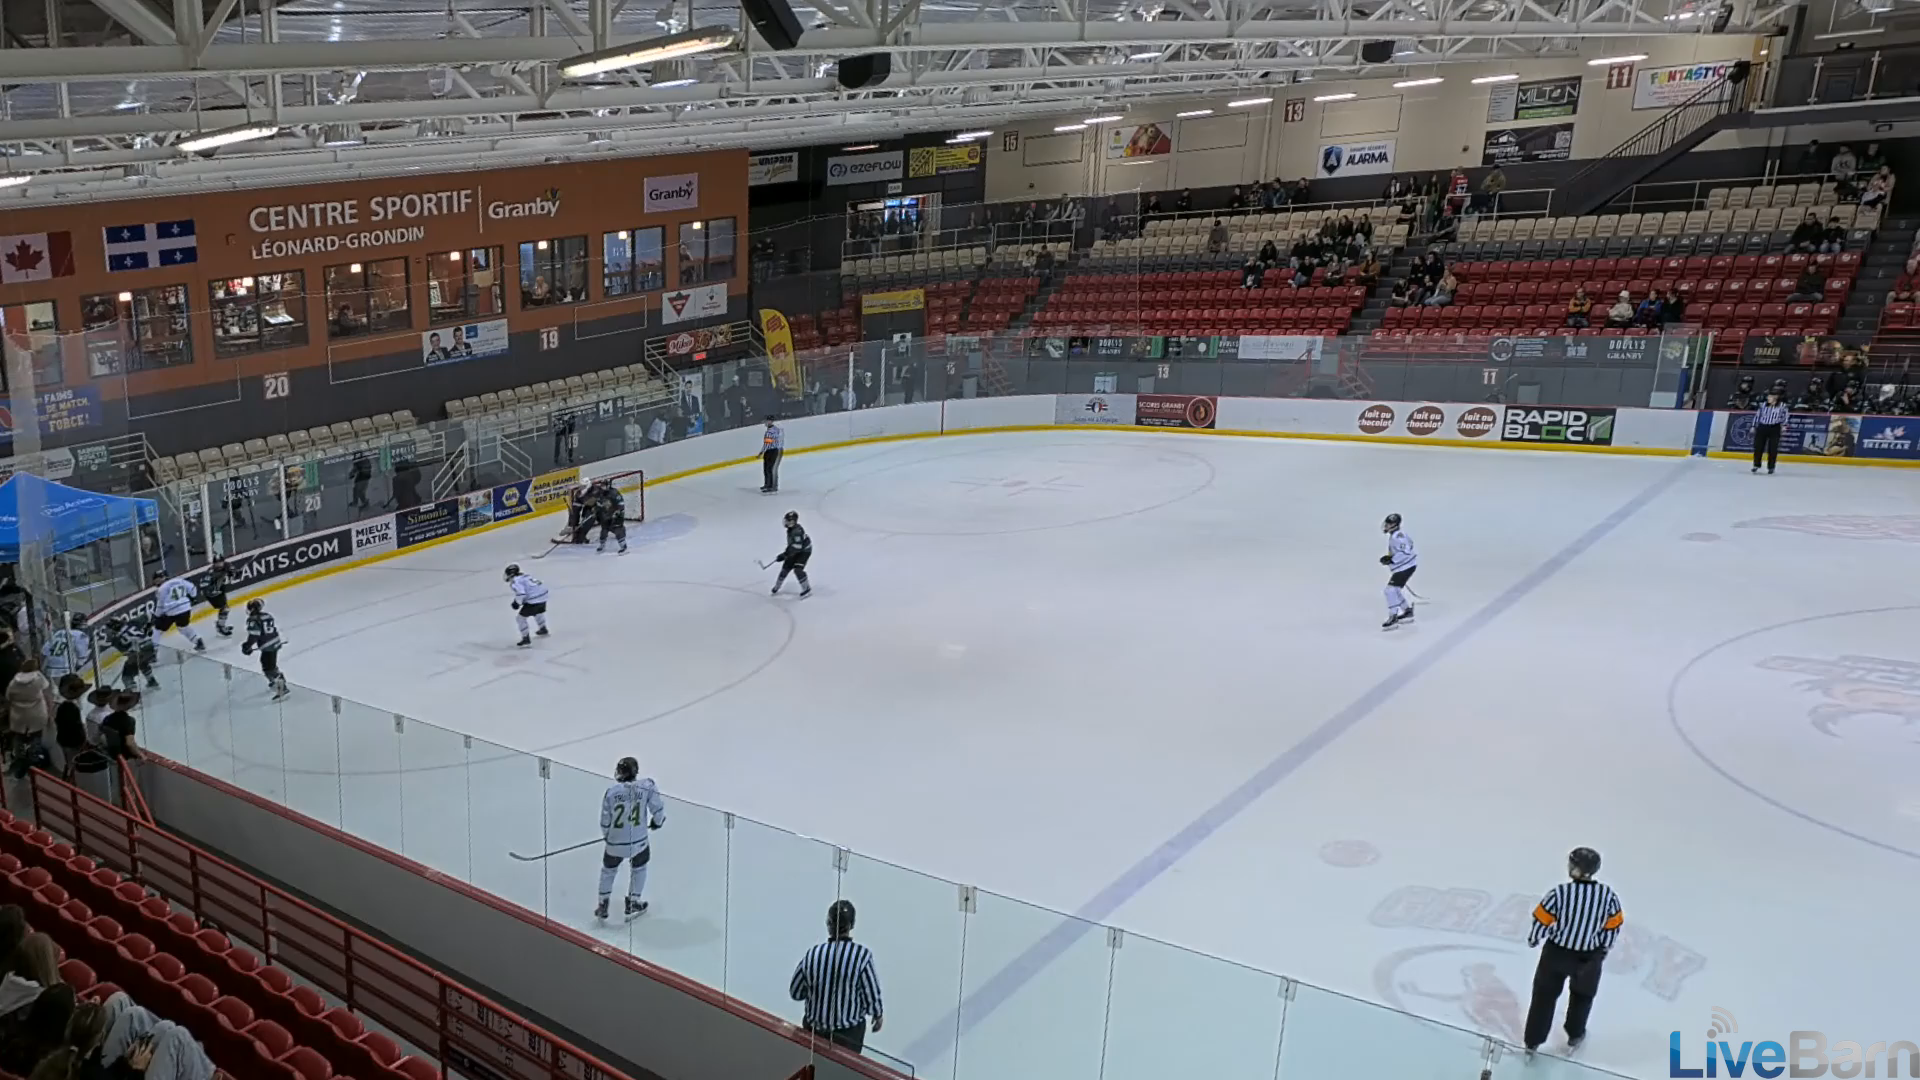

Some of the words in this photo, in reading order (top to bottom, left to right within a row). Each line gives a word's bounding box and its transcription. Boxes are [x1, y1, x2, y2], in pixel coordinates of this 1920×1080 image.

[1610, 66, 1632, 88] 11
[1286, 102, 1304, 122] 13
[1005, 136, 1017, 151] 15
[1345, 151, 1390, 166] ALARMA
[649, 185, 694, 201] Granby
[249, 200, 359, 233] CENTRE
[369, 189, 473, 222] SPORTIF
[487, 196, 560, 220] Granby
[251, 226, 425, 260] LÉONARD-GRONDIN
[541, 331, 559, 350] 19
[1157, 367, 1170, 379] 13
[1483, 371, 1497, 385] 11
[265, 376, 289, 399] 20
[1365, 410, 1379, 419] lait
[1413, 411, 1429, 420] lait
[1464, 412, 1480, 421] lait
[1481, 414, 1494, 422] au
[1506, 409, 1588, 426] RAPID
[1358, 419, 1393, 428] chocolat
[1406, 420, 1442, 429] chocolat
[1457, 421, 1494, 431] chocolat
[1504, 424, 1585, 442] BLOC
[304, 495, 321, 513] 20
[355, 521, 391, 537] MIEUX
[613, 803, 641, 829] 24
